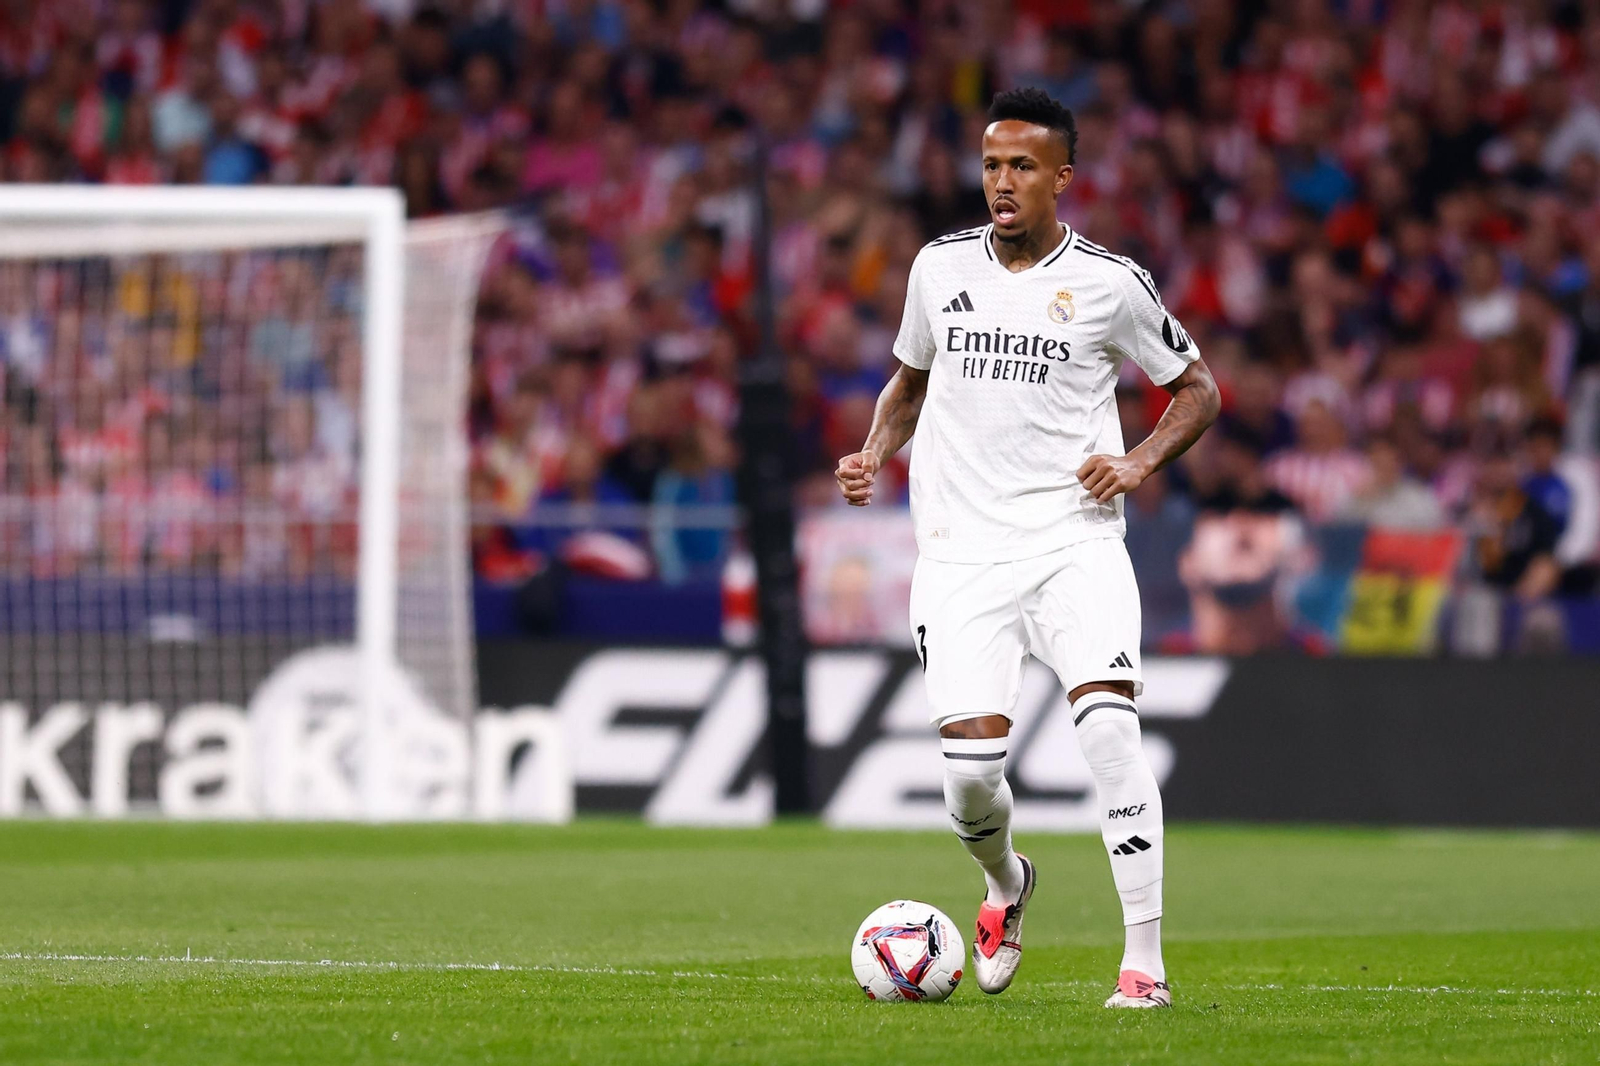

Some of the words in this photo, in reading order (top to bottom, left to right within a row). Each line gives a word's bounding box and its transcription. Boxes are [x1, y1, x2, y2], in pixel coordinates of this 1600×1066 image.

[946, 327, 1071, 362] Emirates
[963, 357, 988, 379] FLY
[991, 359, 1049, 384] BETTER
[0, 700, 573, 822] kraken
[1108, 803, 1147, 819] RMCF
